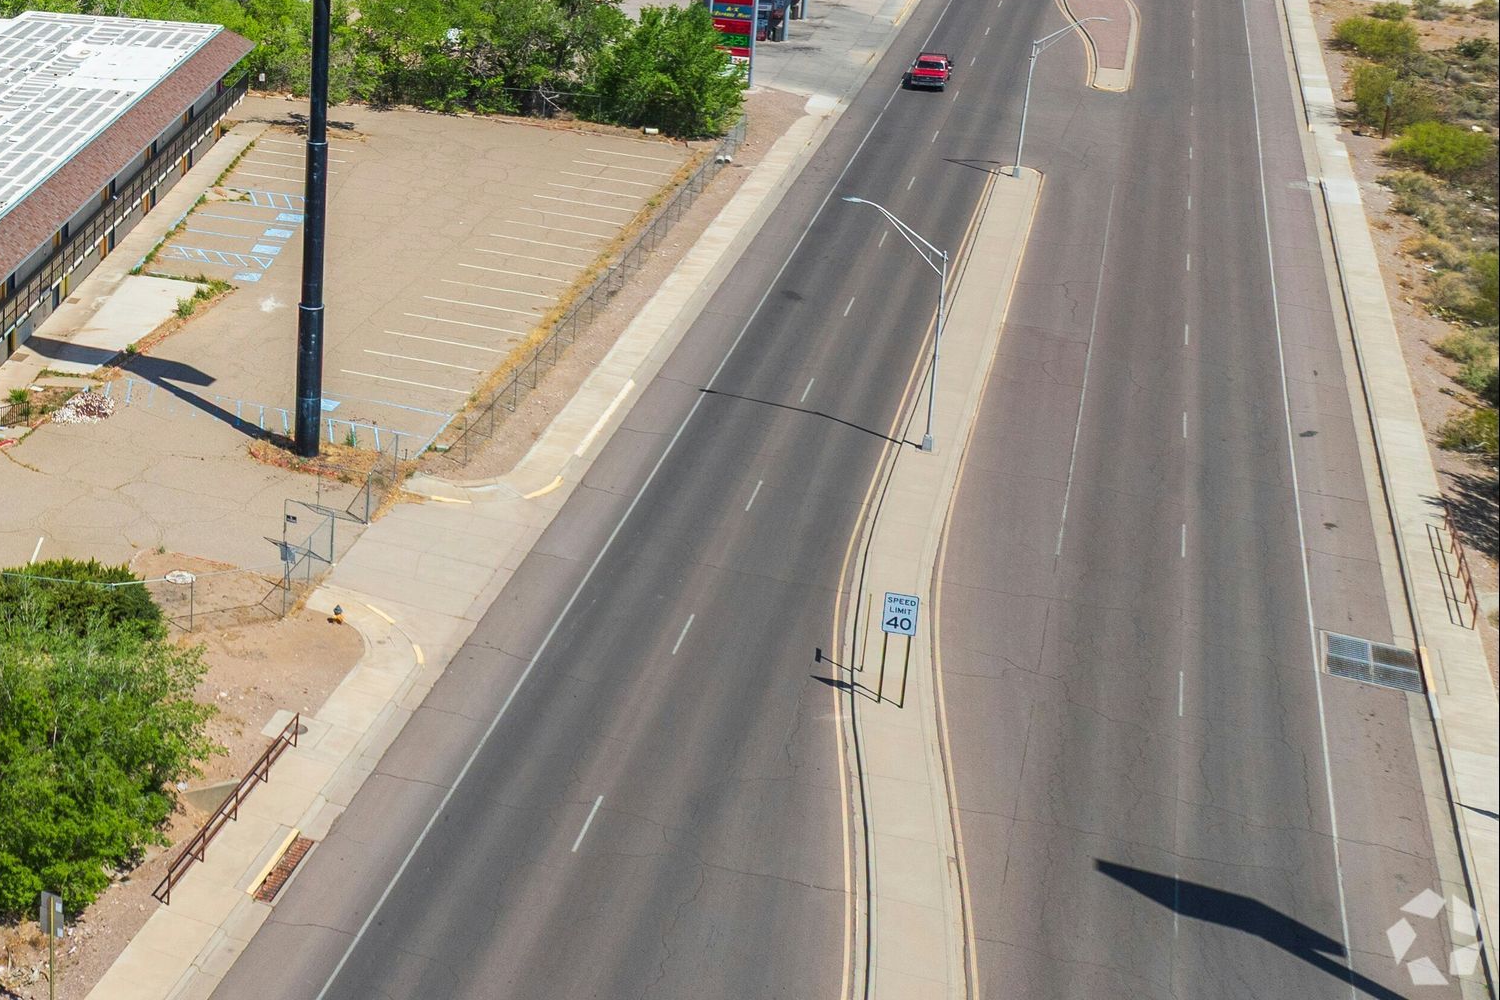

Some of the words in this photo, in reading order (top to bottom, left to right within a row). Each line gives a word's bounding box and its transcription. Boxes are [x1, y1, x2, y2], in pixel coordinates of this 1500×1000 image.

[887, 596, 916, 606] SPEED
[889, 606, 912, 615] LIMIT
[885, 616, 912, 631] 40
